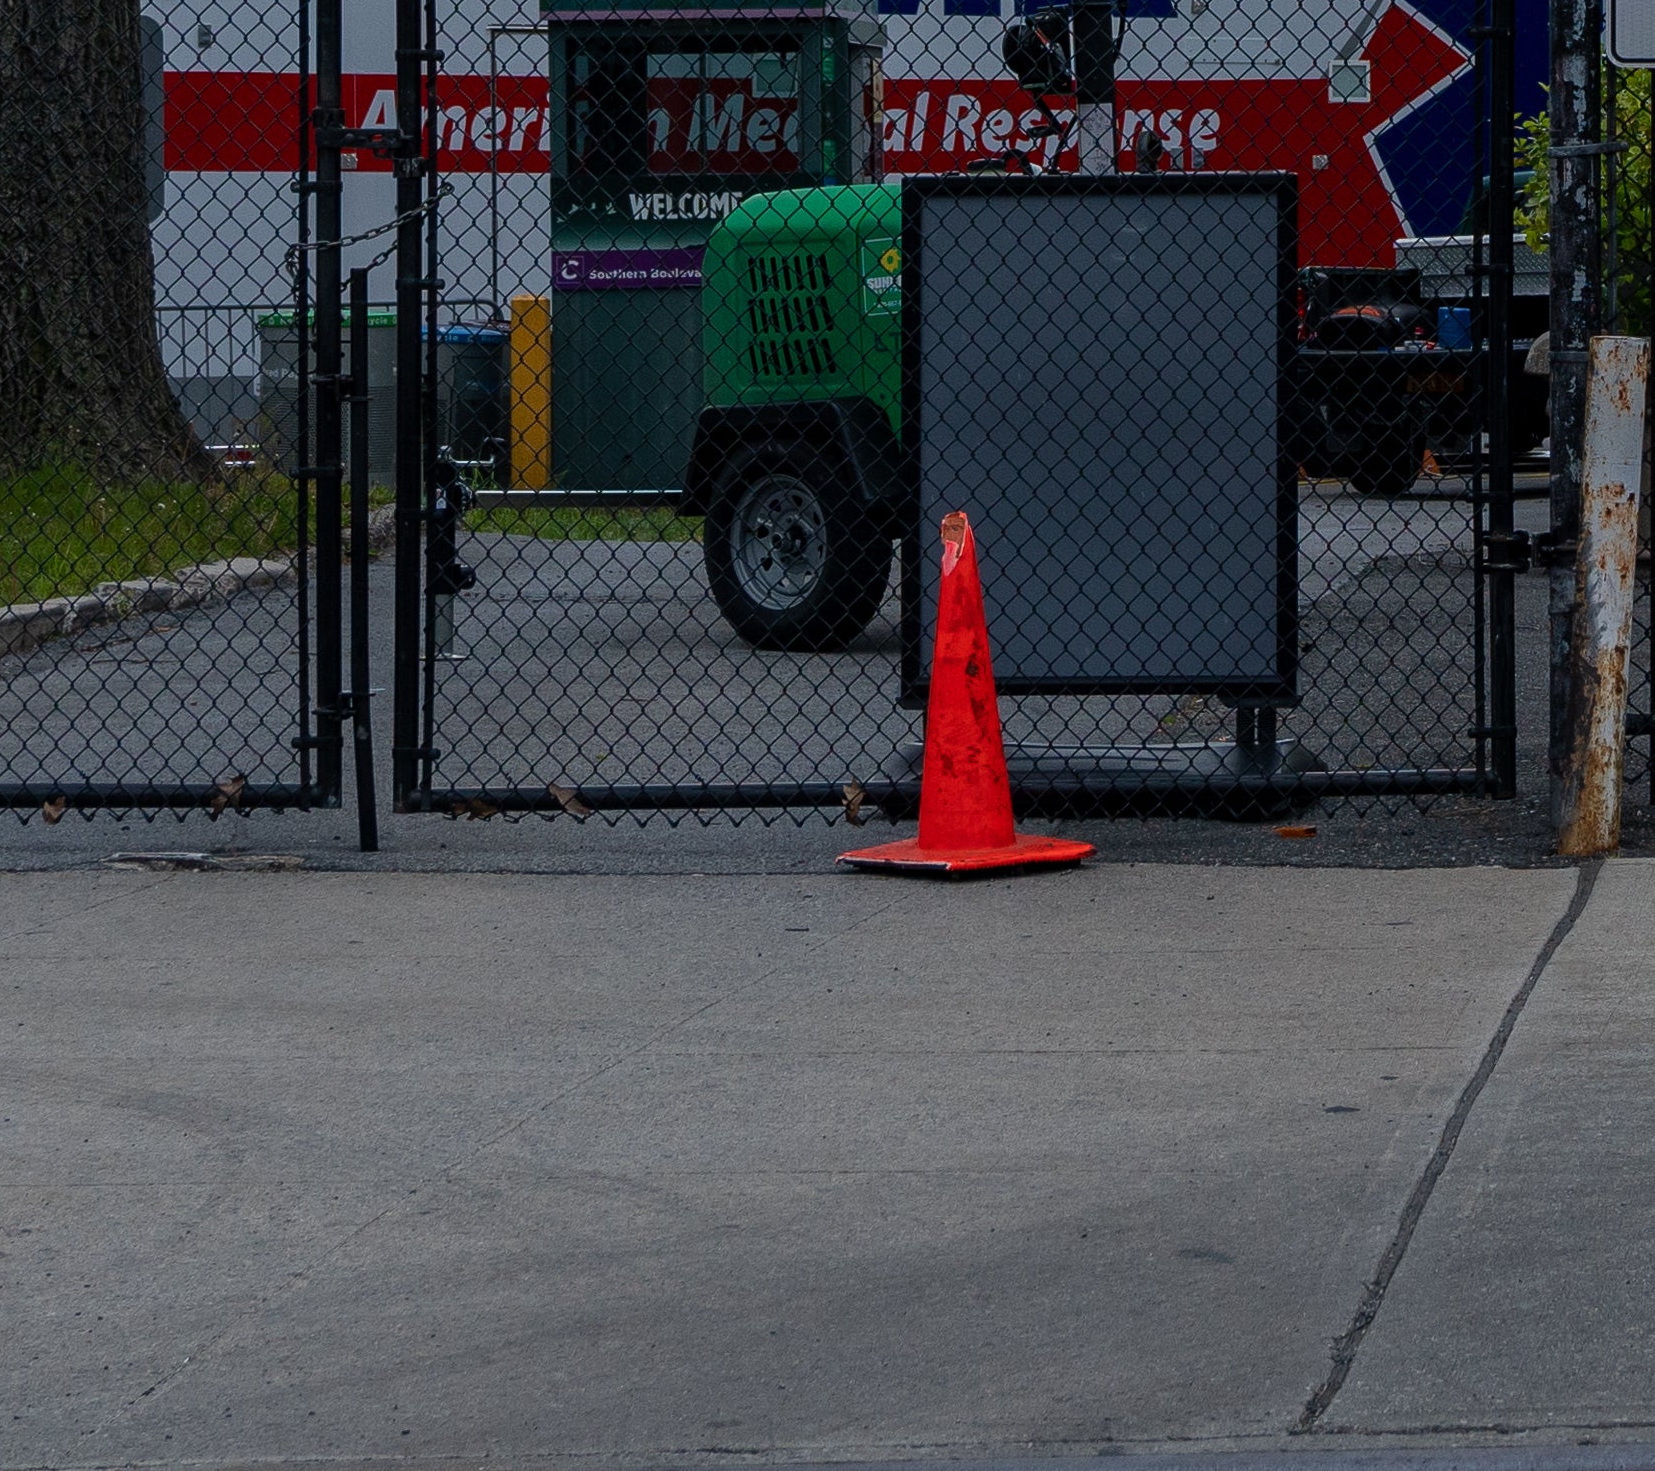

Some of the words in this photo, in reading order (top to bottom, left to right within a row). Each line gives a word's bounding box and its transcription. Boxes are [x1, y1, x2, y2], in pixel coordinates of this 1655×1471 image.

[360, 89, 671, 154] Amerin
[942, 94, 1220, 164] Respnse
[588, 268, 647, 280] Southern
